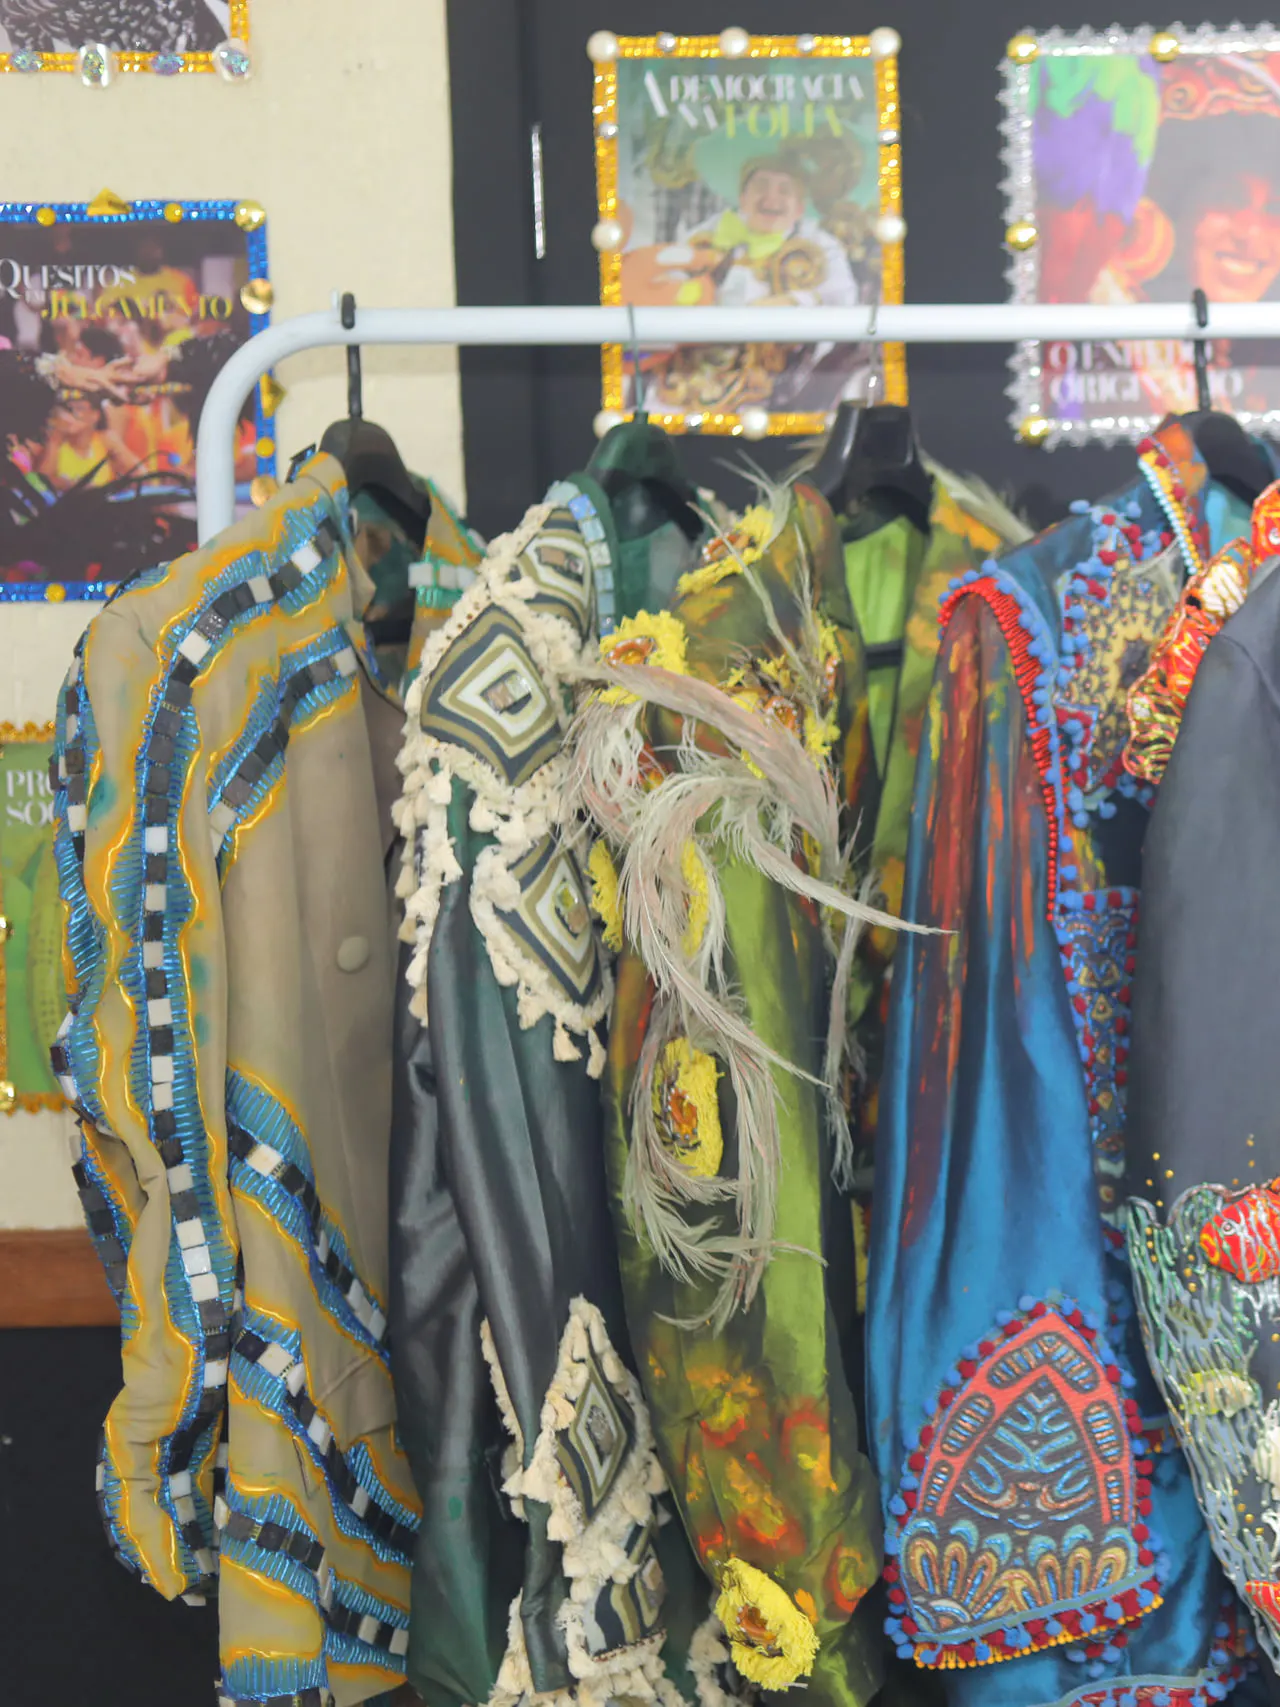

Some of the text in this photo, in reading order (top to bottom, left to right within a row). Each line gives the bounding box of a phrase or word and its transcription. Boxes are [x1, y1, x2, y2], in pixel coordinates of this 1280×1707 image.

[670, 74, 865, 102] DEMOCRACIA
[725, 103, 843, 138] FOLIA
[0, 258, 137, 299] QUESITOS
[41, 290, 234, 321] JULGAMENTO
